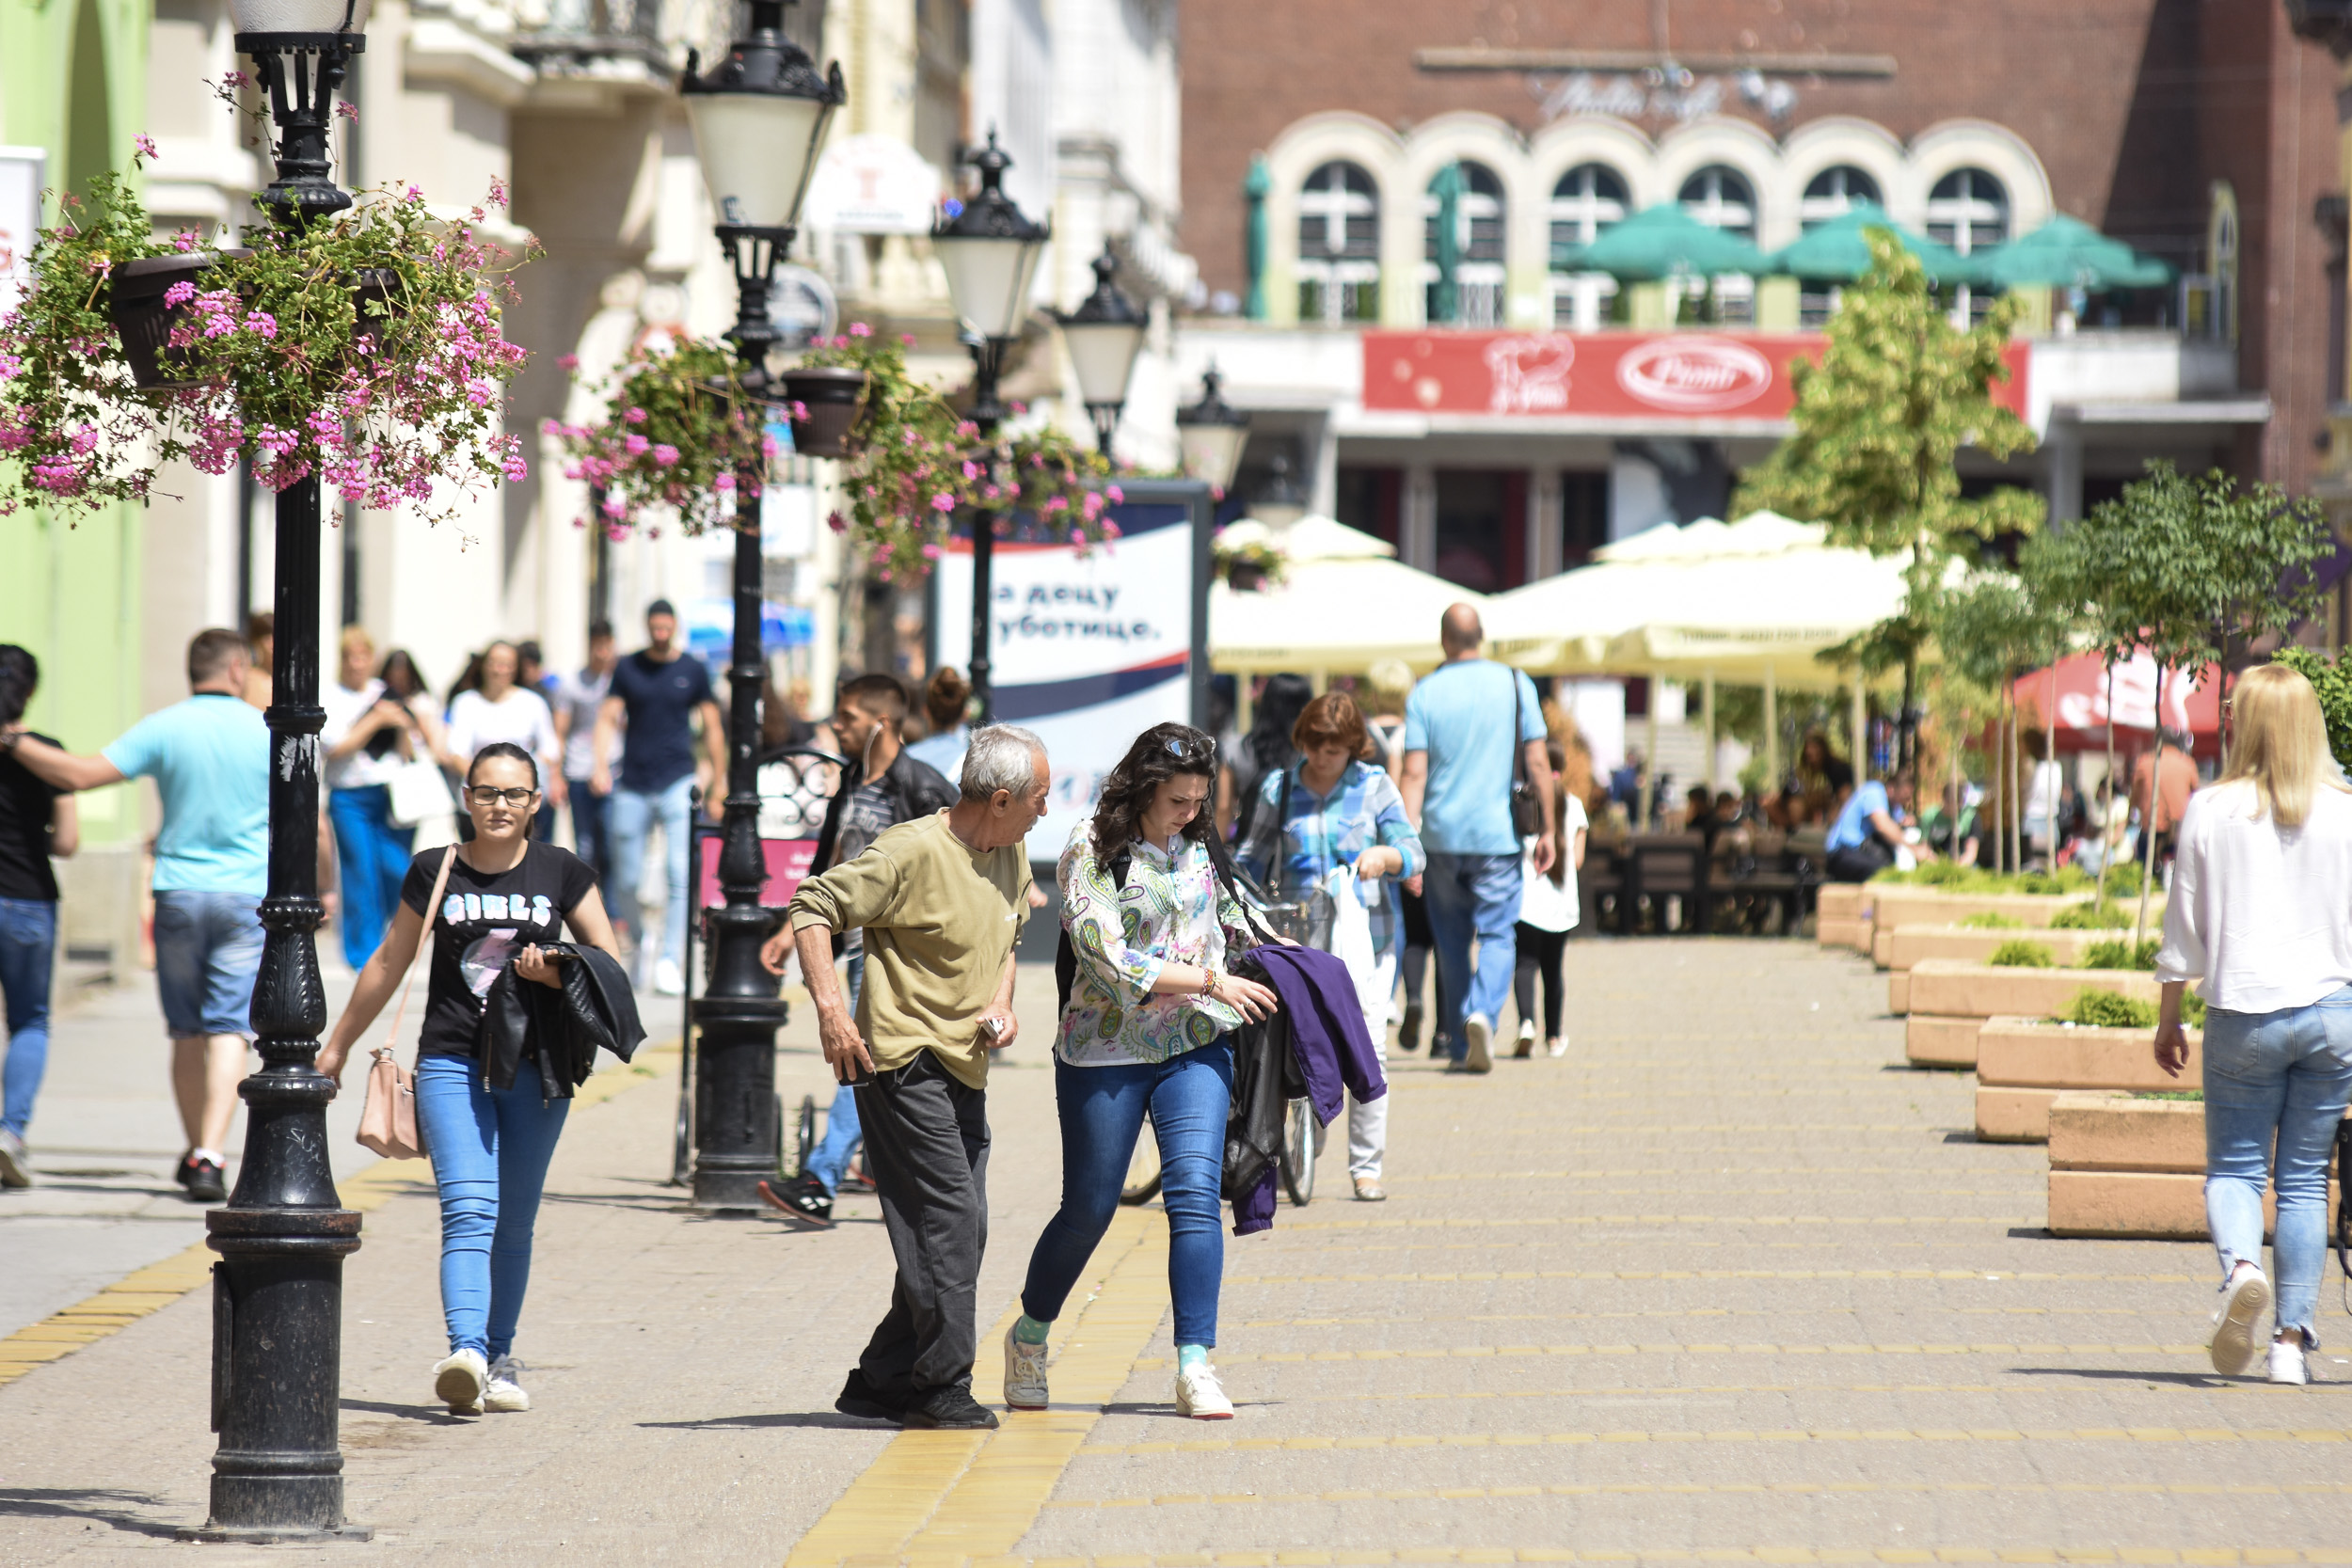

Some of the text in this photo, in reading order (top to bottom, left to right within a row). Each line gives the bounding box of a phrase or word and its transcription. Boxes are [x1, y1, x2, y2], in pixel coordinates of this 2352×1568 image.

[1026, 585, 1118, 611] децу
[997, 612, 1161, 646] уботице.
[443, 893, 551, 927] GIRLS
